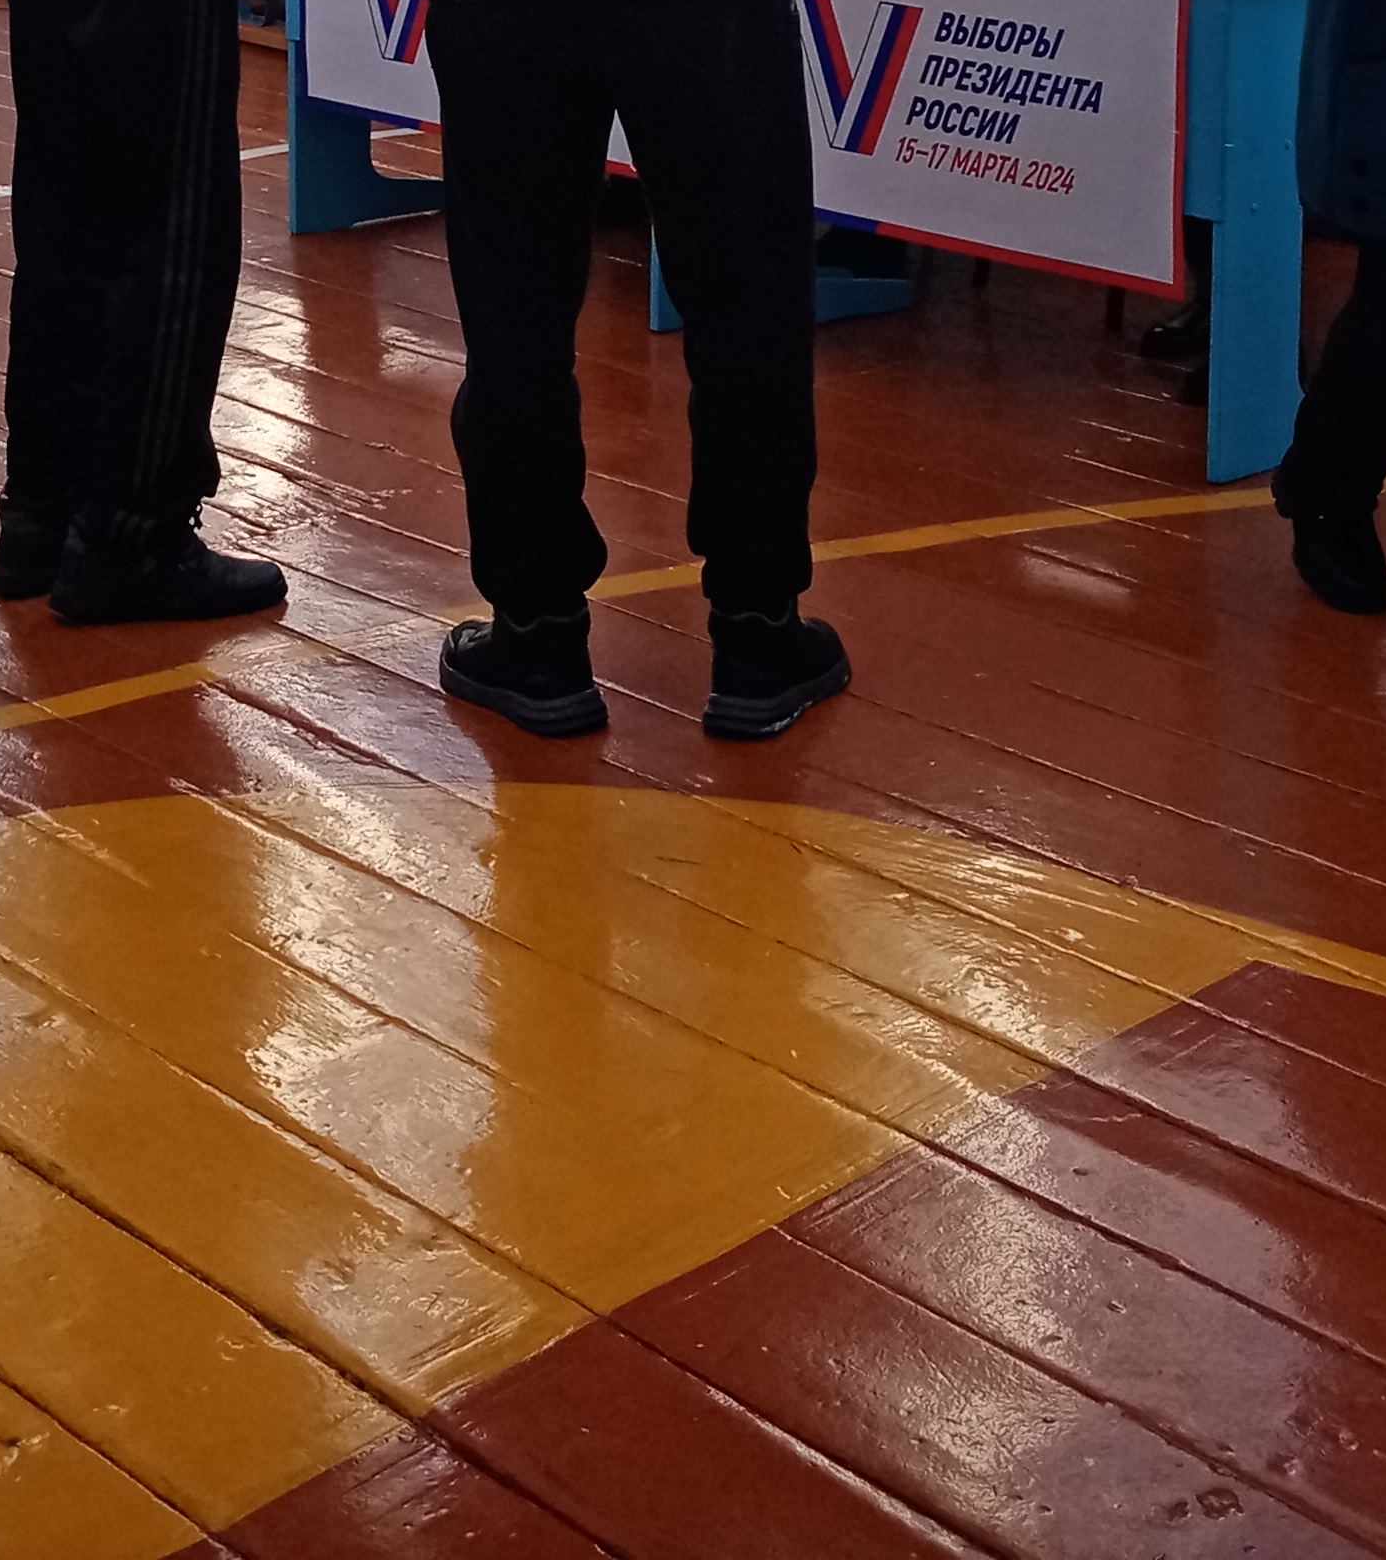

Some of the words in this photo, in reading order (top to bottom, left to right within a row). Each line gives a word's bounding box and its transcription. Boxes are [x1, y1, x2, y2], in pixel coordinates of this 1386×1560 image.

[934, 11, 1065, 60] ВЫБОРЫ
[919, 54, 1104, 114] ПРЕЗИДЕНТА
[905, 95, 1021, 145] РОССИИ
[950, 146, 1020, 185] МАРТА
[1021, 160, 1075, 195] 2024
